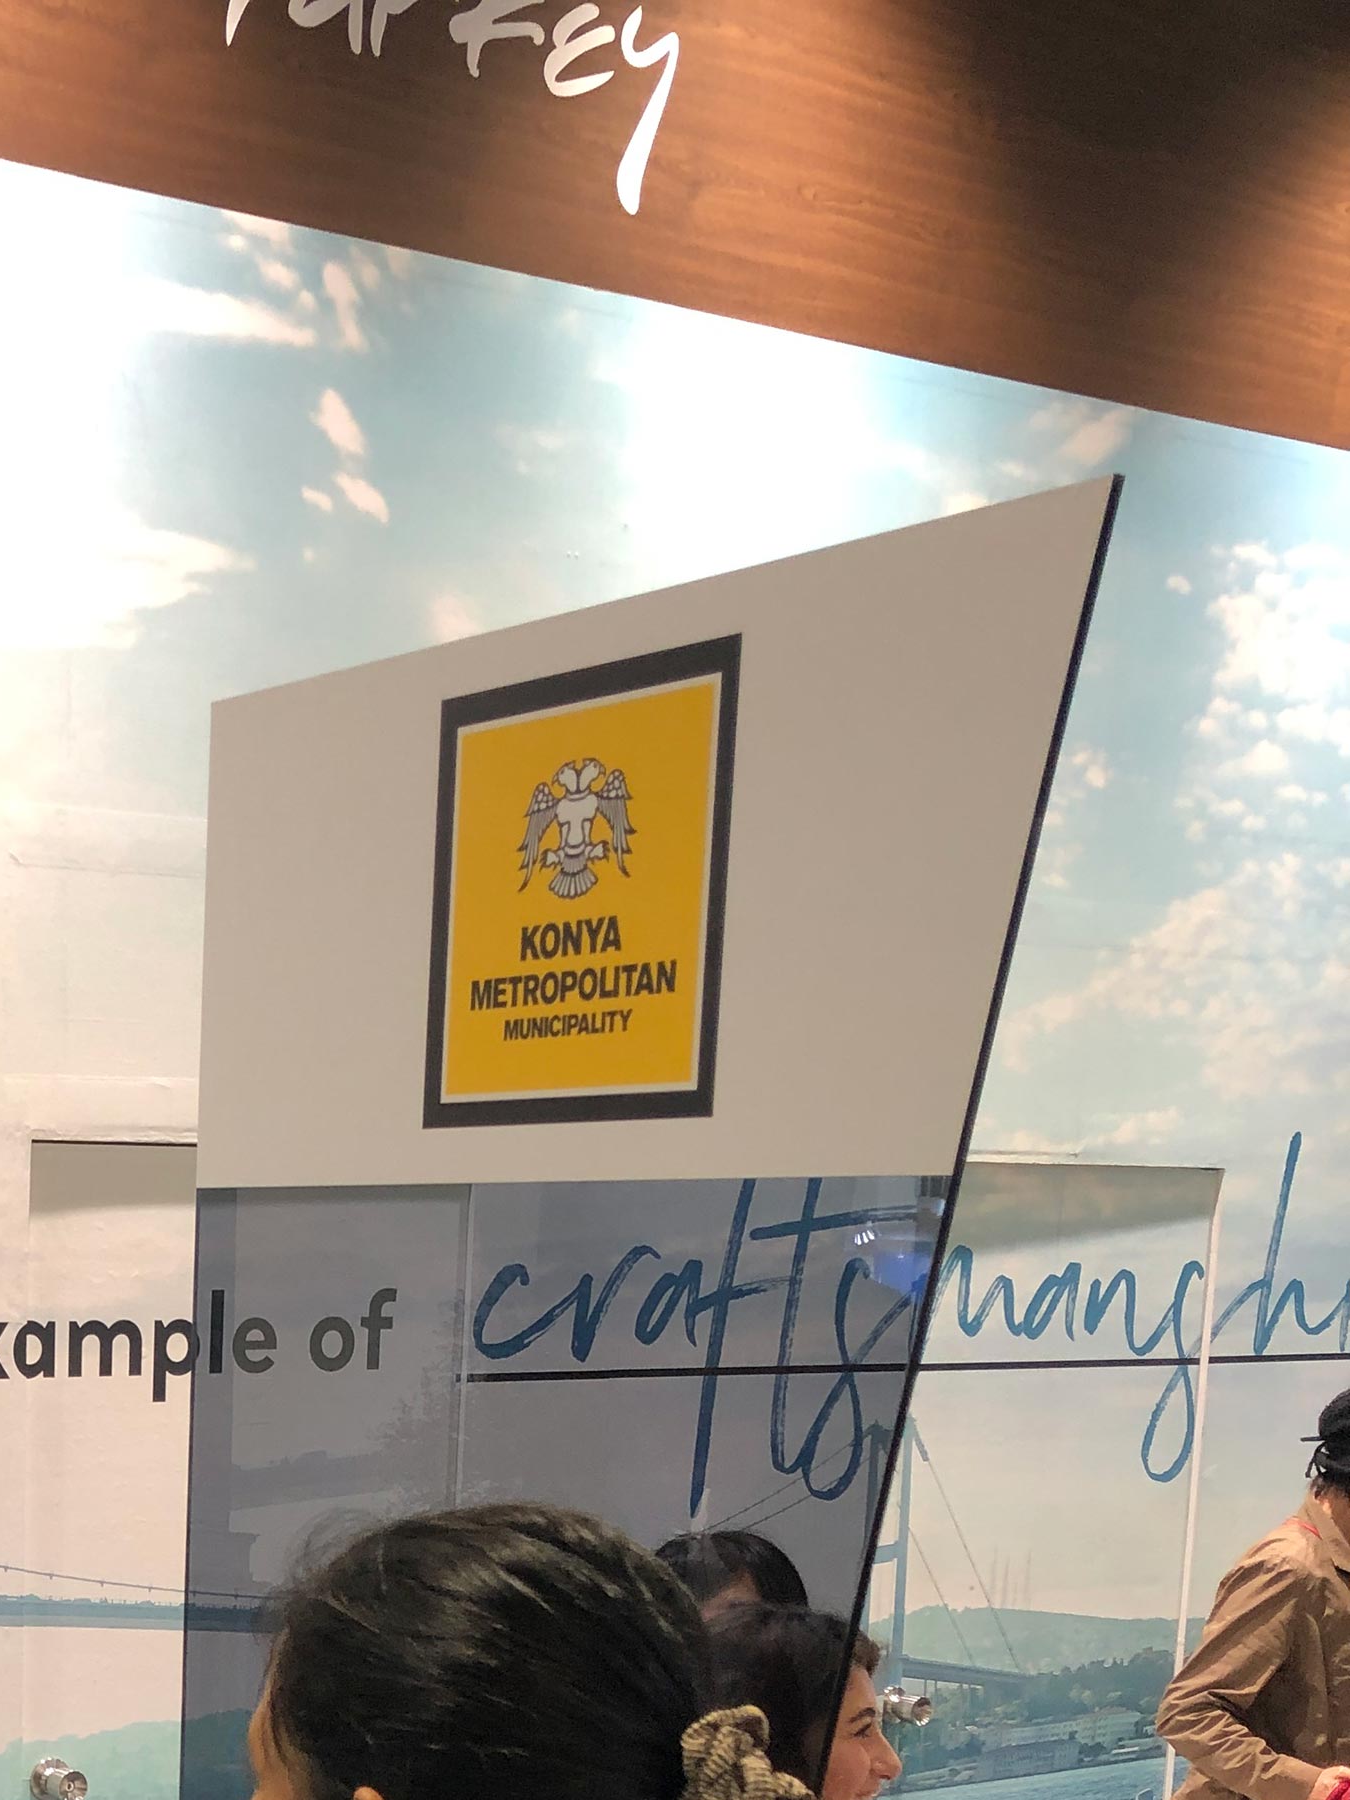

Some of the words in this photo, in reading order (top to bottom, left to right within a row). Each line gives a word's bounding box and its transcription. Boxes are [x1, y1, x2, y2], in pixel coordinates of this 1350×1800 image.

[519, 914, 623, 962] KONYA
[469, 959, 679, 1012] METROPOLITAN
[503, 1008, 634, 1041] MUNICIPALITY
[308, 1287, 399, 1372] of
